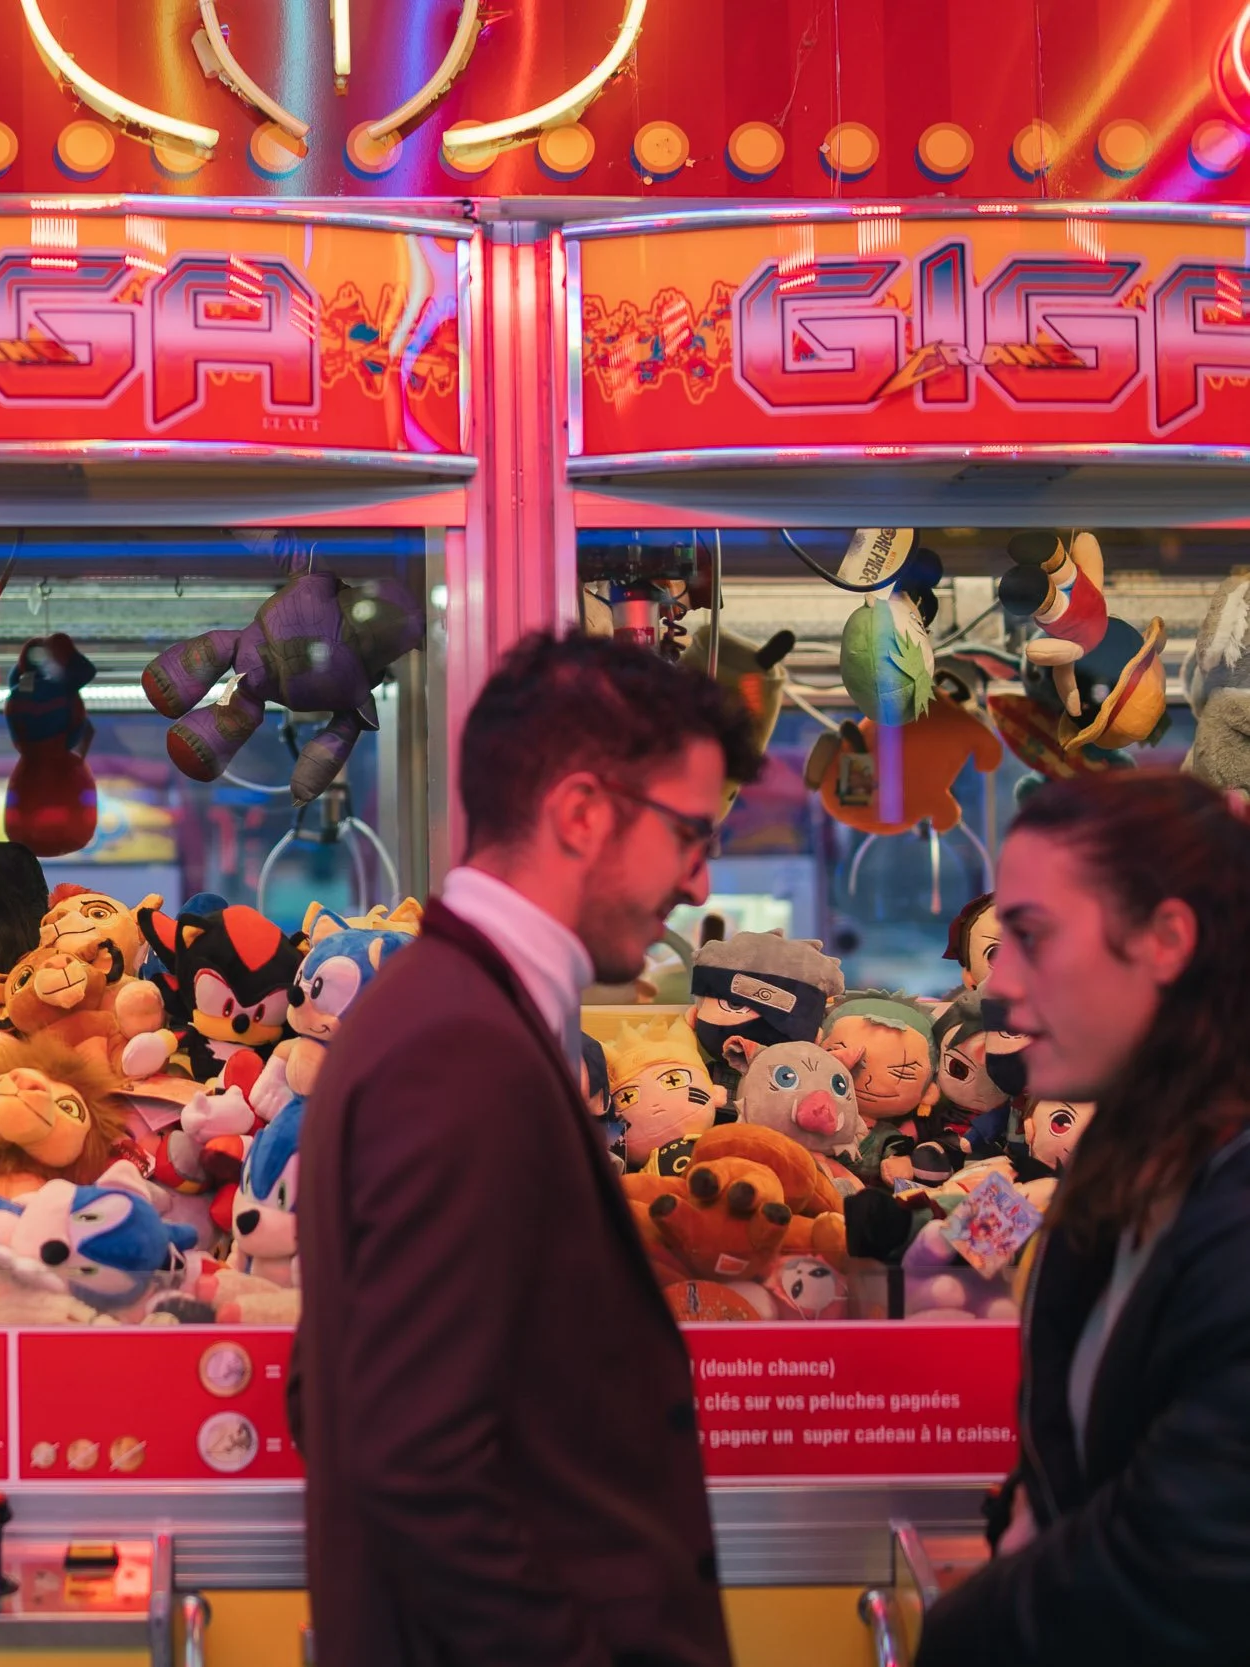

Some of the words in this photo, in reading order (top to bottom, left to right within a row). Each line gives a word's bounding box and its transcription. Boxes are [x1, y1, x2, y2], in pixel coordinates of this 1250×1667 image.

[699, 1358, 764, 1379] (double
[767, 1358, 835, 1379] chance)
[704, 1392, 741, 1411] clés
[744, 1395, 772, 1411] sur
[775, 1394, 805, 1411] vos
[808, 1392, 885, 1413] peluches
[890, 1390, 961, 1413] gagnées
[709, 1429, 768, 1449] gagner
[772, 1429, 794, 1445] un
[803, 1427, 850, 1447] super
[855, 1426, 916, 1444] cadeau
[920, 1424, 931, 1443] à
[936, 1424, 951, 1443] la
[957, 1424, 1017, 1443] caisse.
